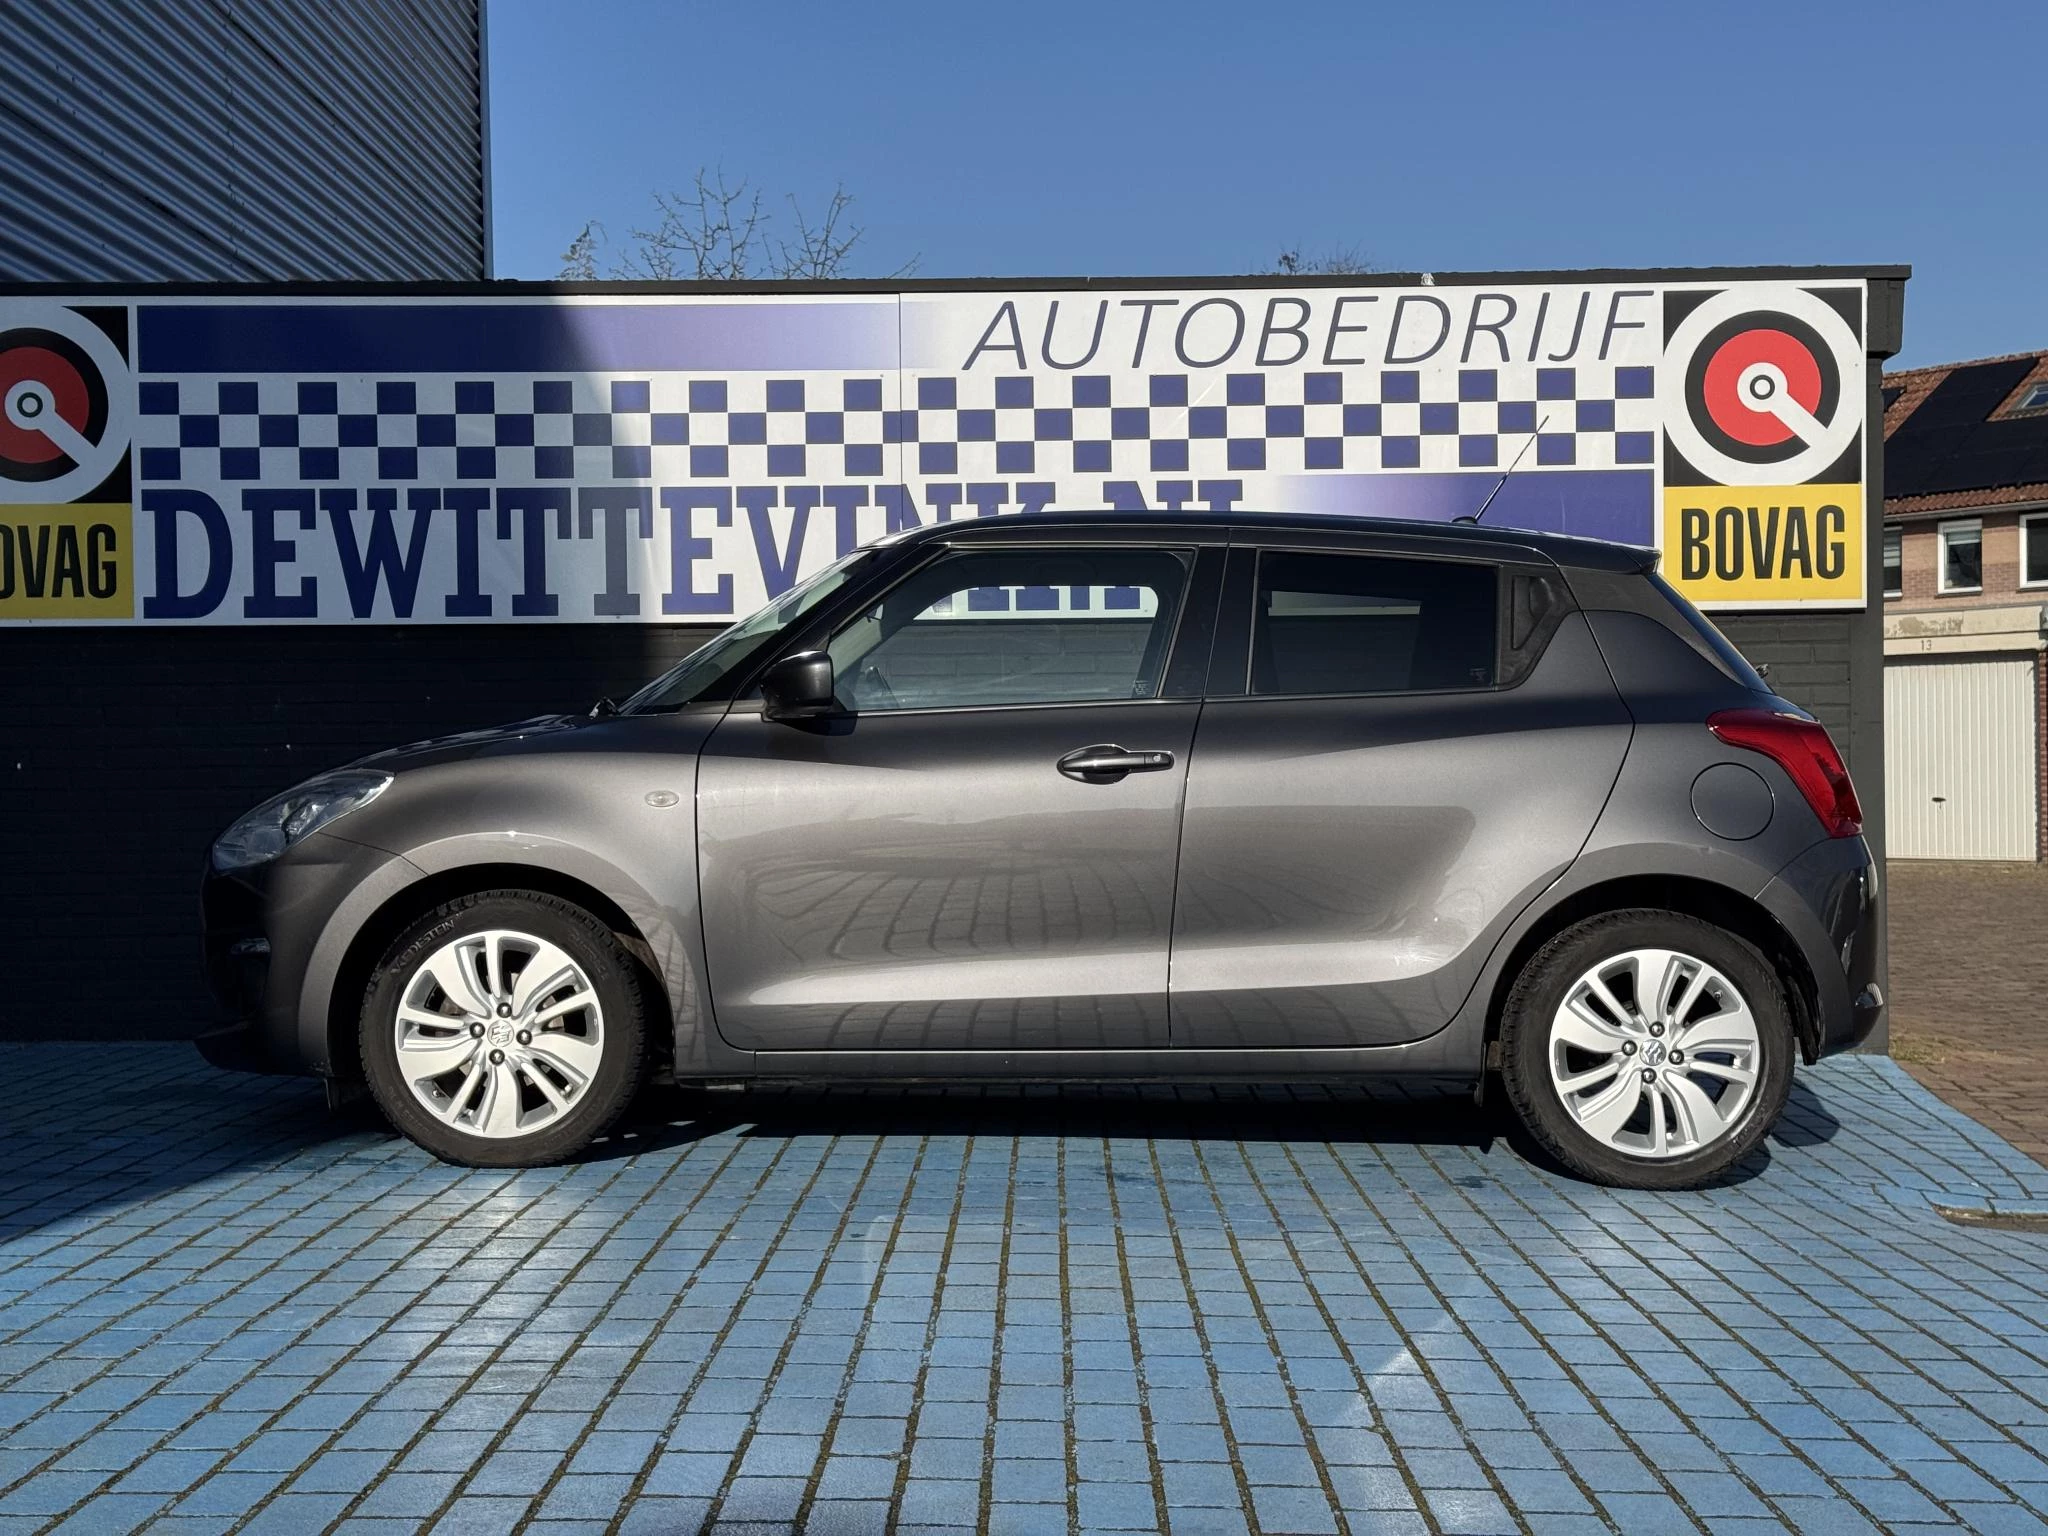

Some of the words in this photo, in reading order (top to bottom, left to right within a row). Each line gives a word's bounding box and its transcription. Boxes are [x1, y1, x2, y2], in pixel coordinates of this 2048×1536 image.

[961, 290, 1655, 371] AUTOBEDRIJF
[141, 480, 1243, 619] DEWITTEVI.
[1681, 504, 1846, 581] BOVAG
[1921, 639, 1932, 650] 13
